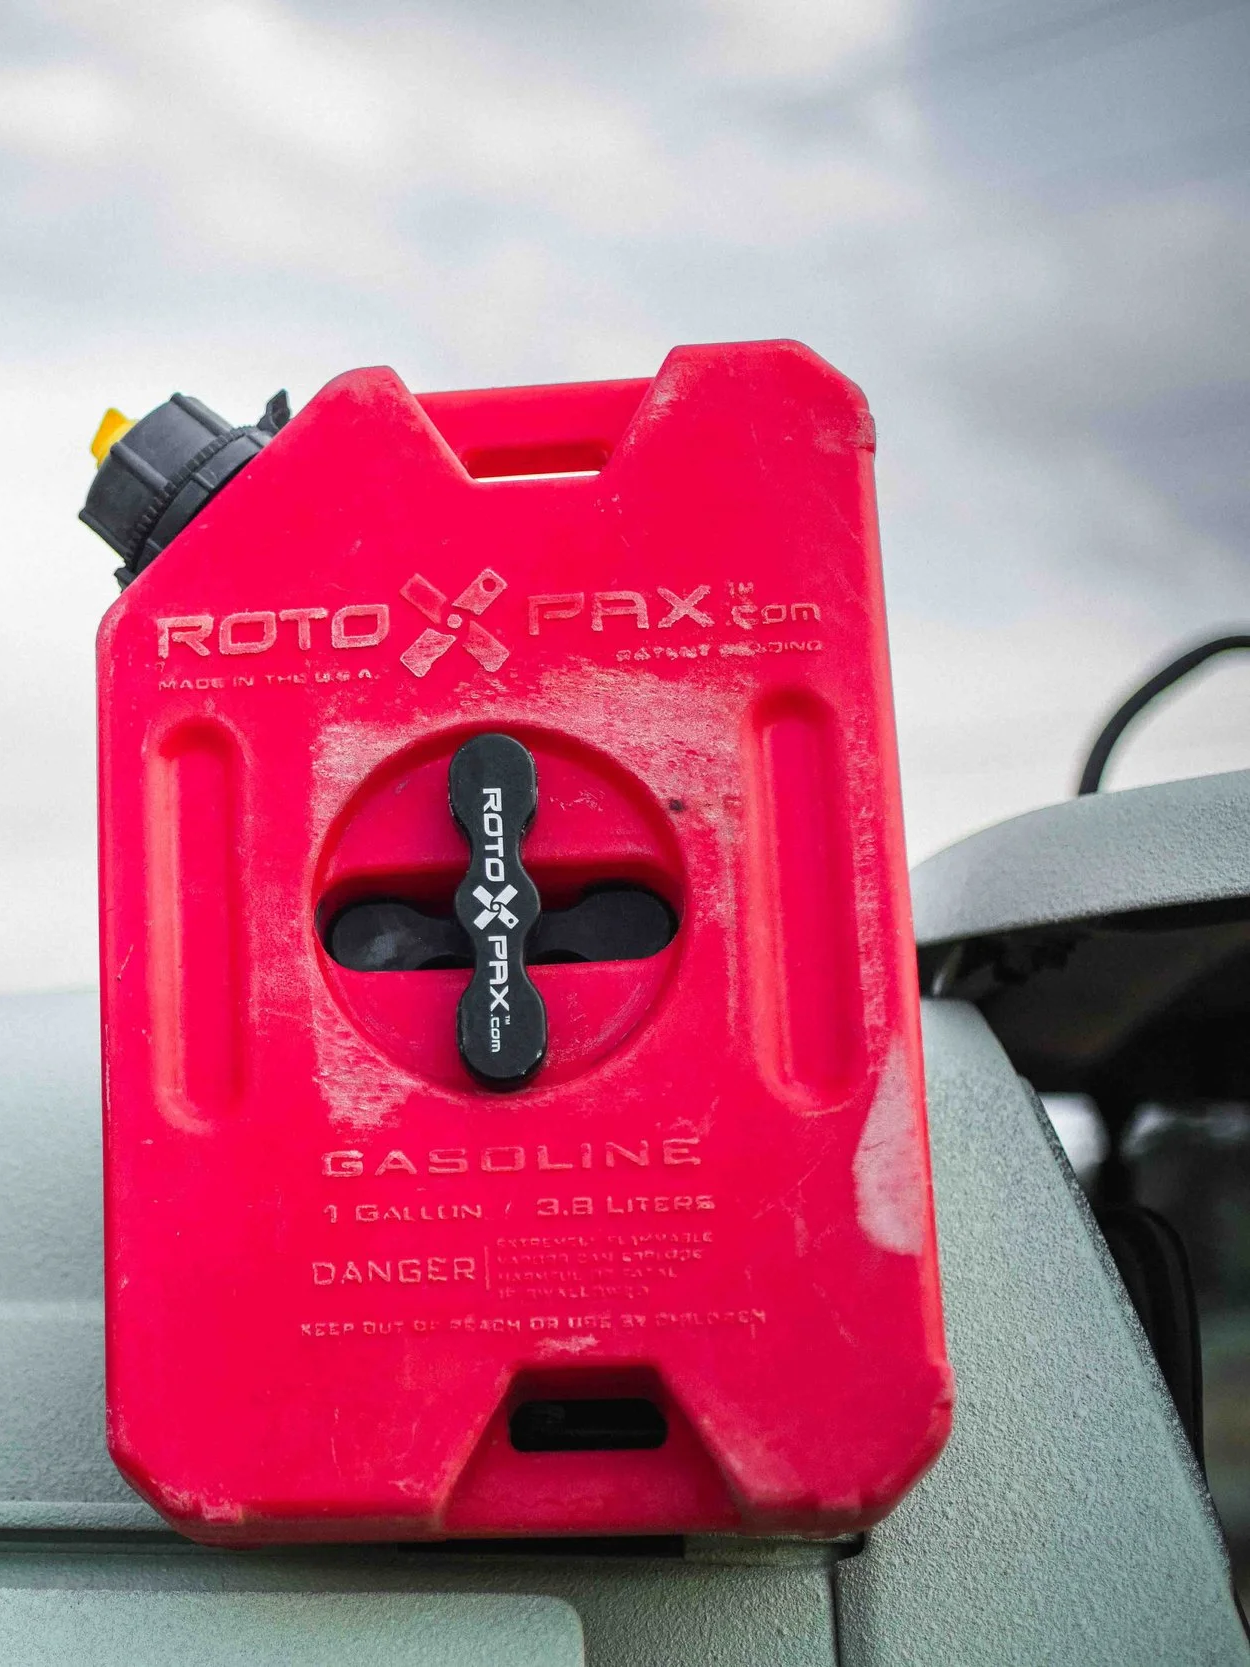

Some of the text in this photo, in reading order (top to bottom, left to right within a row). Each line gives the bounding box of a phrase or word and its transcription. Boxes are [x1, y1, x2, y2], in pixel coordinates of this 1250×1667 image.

[156, 604, 390, 659] ROTO
[528, 584, 715, 635] PAX
[158, 677, 225, 691] MADE
[233, 674, 255, 687] IN
[482, 787, 505, 882] ROTO
[488, 935, 510, 1012] PAX
[490, 1009, 501, 1054] .com
[321, 1137, 702, 1178] GASOLINE
[323, 1204, 338, 1223] 1
[355, 1203, 482, 1222] GALLON
[536, 1196, 594, 1217] 3.8
[607, 1193, 716, 1214] LITERS
[312, 1256, 476, 1285] DANGER
[301, 1322, 355, 1336] KEEP
[363, 1321, 405, 1334] OUT
